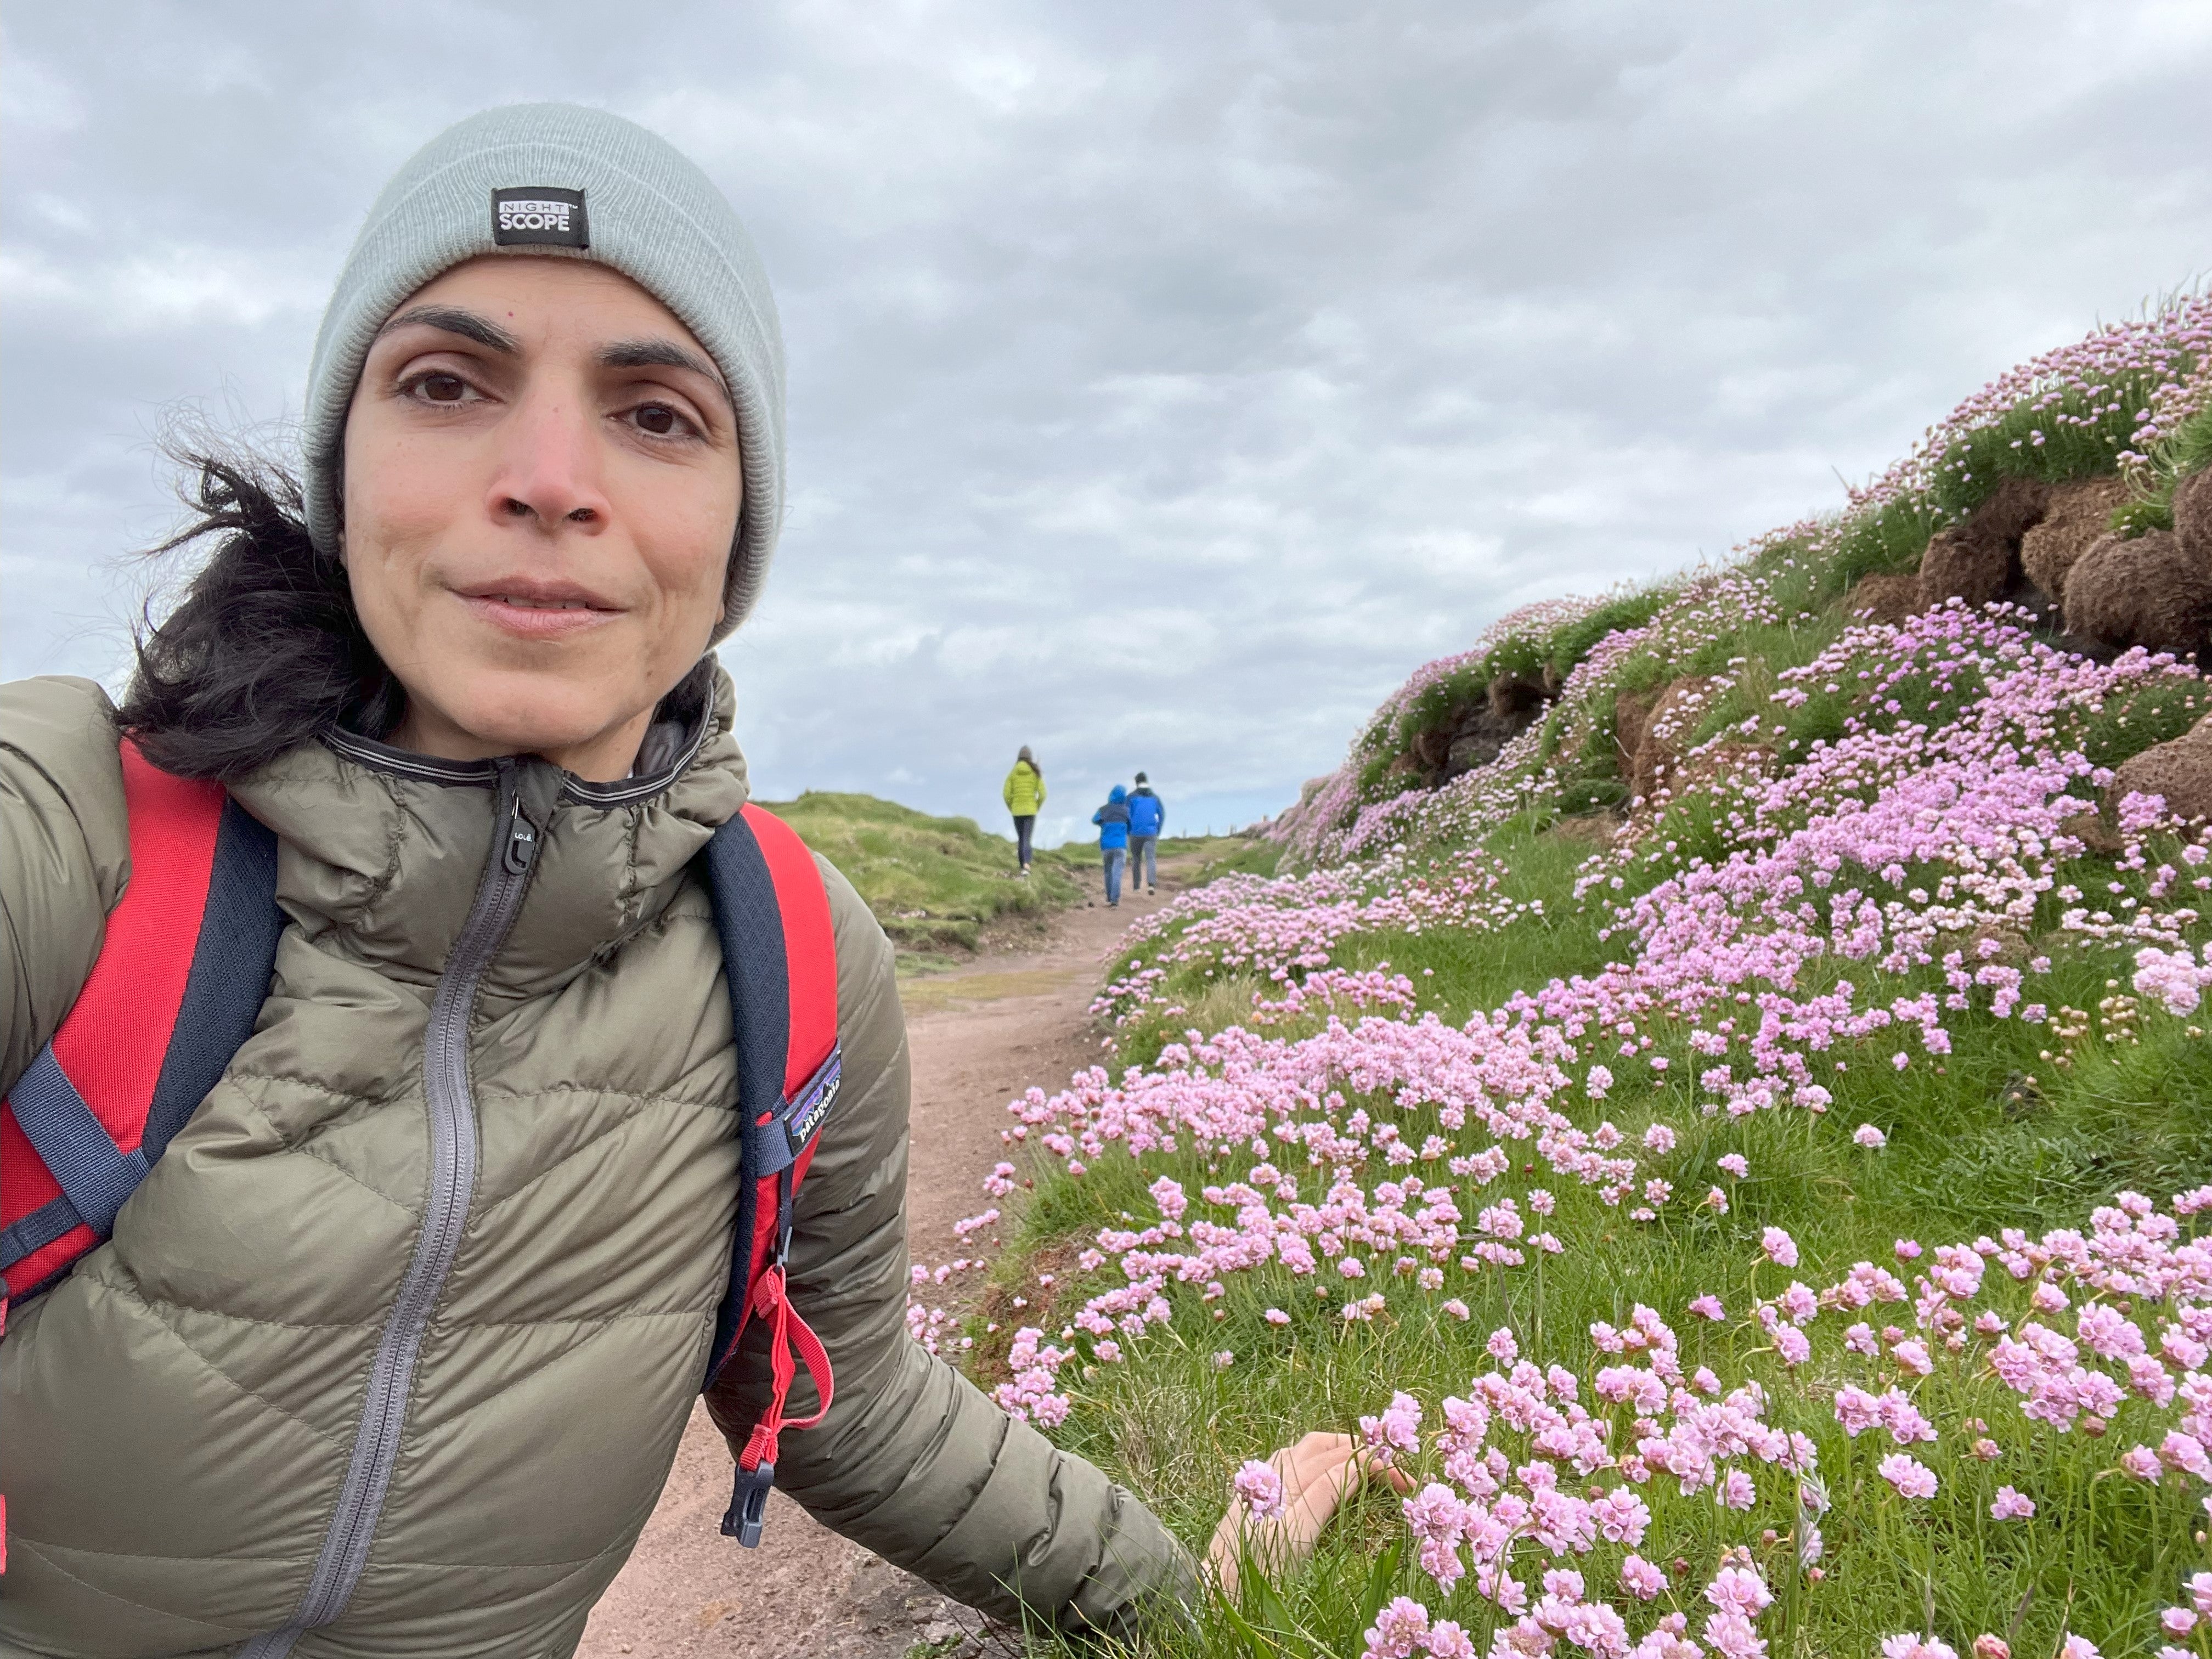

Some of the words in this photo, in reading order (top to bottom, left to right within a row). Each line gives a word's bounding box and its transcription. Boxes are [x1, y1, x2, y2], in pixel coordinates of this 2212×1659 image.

[504, 203, 564, 212] NIGHT
[499, 213, 569, 231] SCOPE
[799, 1079, 840, 1143] patagonia
